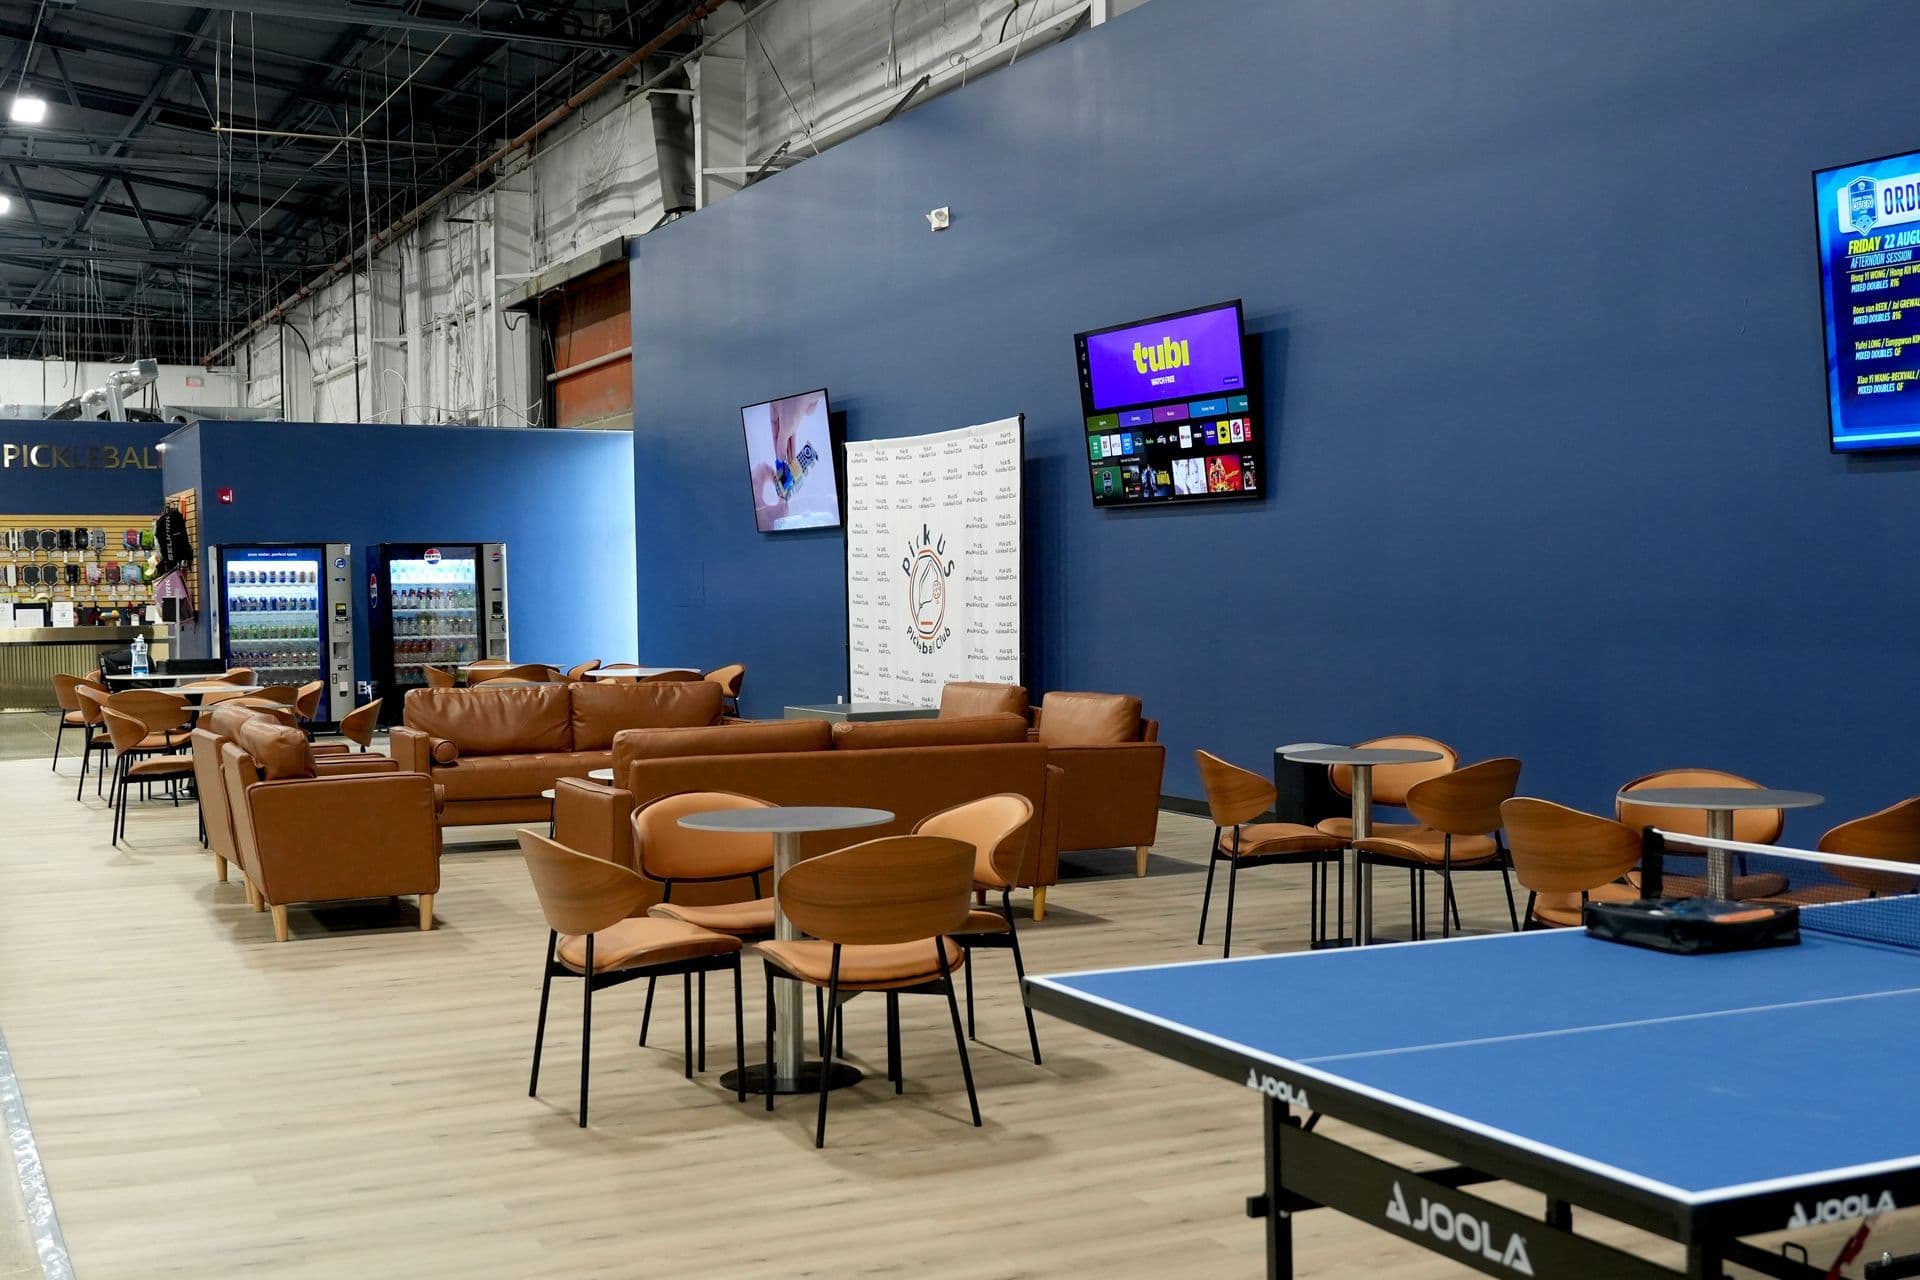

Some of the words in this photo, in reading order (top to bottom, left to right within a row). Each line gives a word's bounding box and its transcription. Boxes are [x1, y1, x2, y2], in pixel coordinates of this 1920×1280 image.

[1848, 236, 1881, 255] FRIDAY
[1884, 233, 1895, 249] 22
[1851, 254, 1885, 269] AFTERNOON
[1886, 250, 1912, 264] SESSION
[1851, 283, 1867, 293] MIXED
[1867, 280, 1889, 291] DOUBLES
[1853, 315, 1869, 325] MIXED
[1869, 312, 1891, 323] DOUBLES
[1133, 336, 1190, 374] tubi
[1855, 350, 1870, 360] MIXED
[1871, 348, 1893, 359] DOUBLES
[1857, 385, 1873, 395] MIXED
[1873, 383, 1896, 393] DOUBLES
[936, 626, 951, 649] Club
[1259, 1074, 1310, 1109] JOOLA
[1808, 1190, 1896, 1224] JOOLA
[1412, 1197, 1534, 1276] JOOLA
